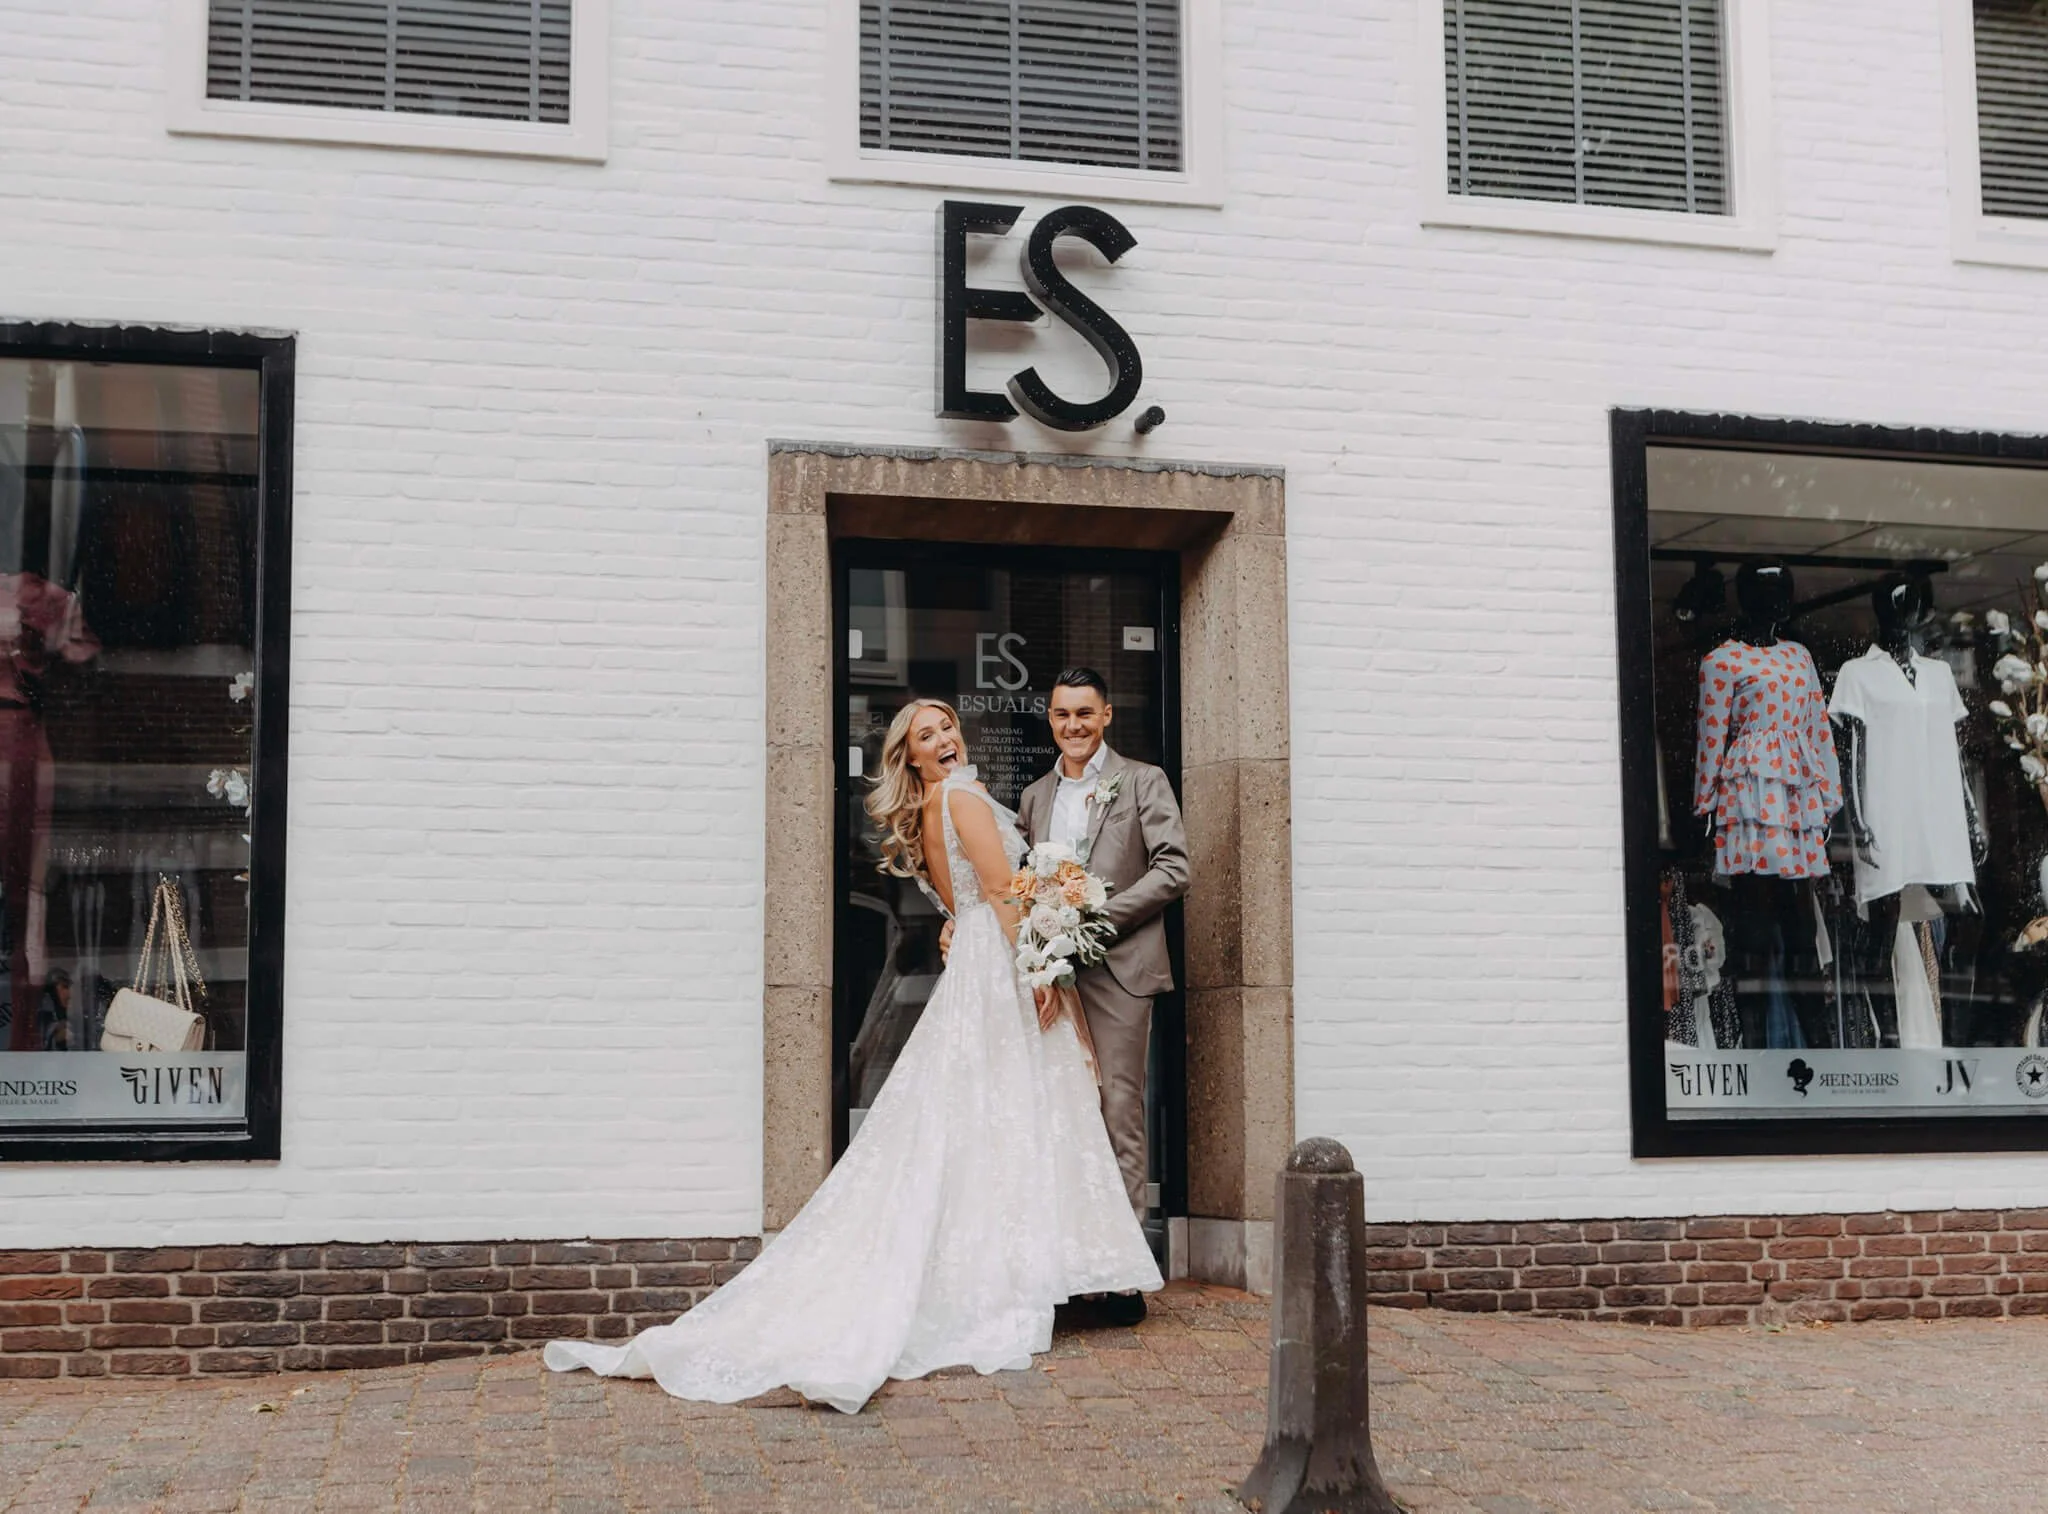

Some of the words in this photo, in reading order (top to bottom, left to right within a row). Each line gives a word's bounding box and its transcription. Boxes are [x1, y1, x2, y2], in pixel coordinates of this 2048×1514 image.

[957, 694, 1046, 714] ESUALS
[981, 727, 1024, 735] MAANDAG
[980, 735, 1023, 744] GESLOTEN
[1003, 745, 1055, 755] DONDERDAG
[985, 763, 1020, 772] VRIJDAG
[986, 782, 1024, 791] ATERDAG
[1670, 1063, 1748, 1096] GIVEN
[0, 1080, 77, 1096] NDERS
[120, 1066, 224, 1104] GIVEN
